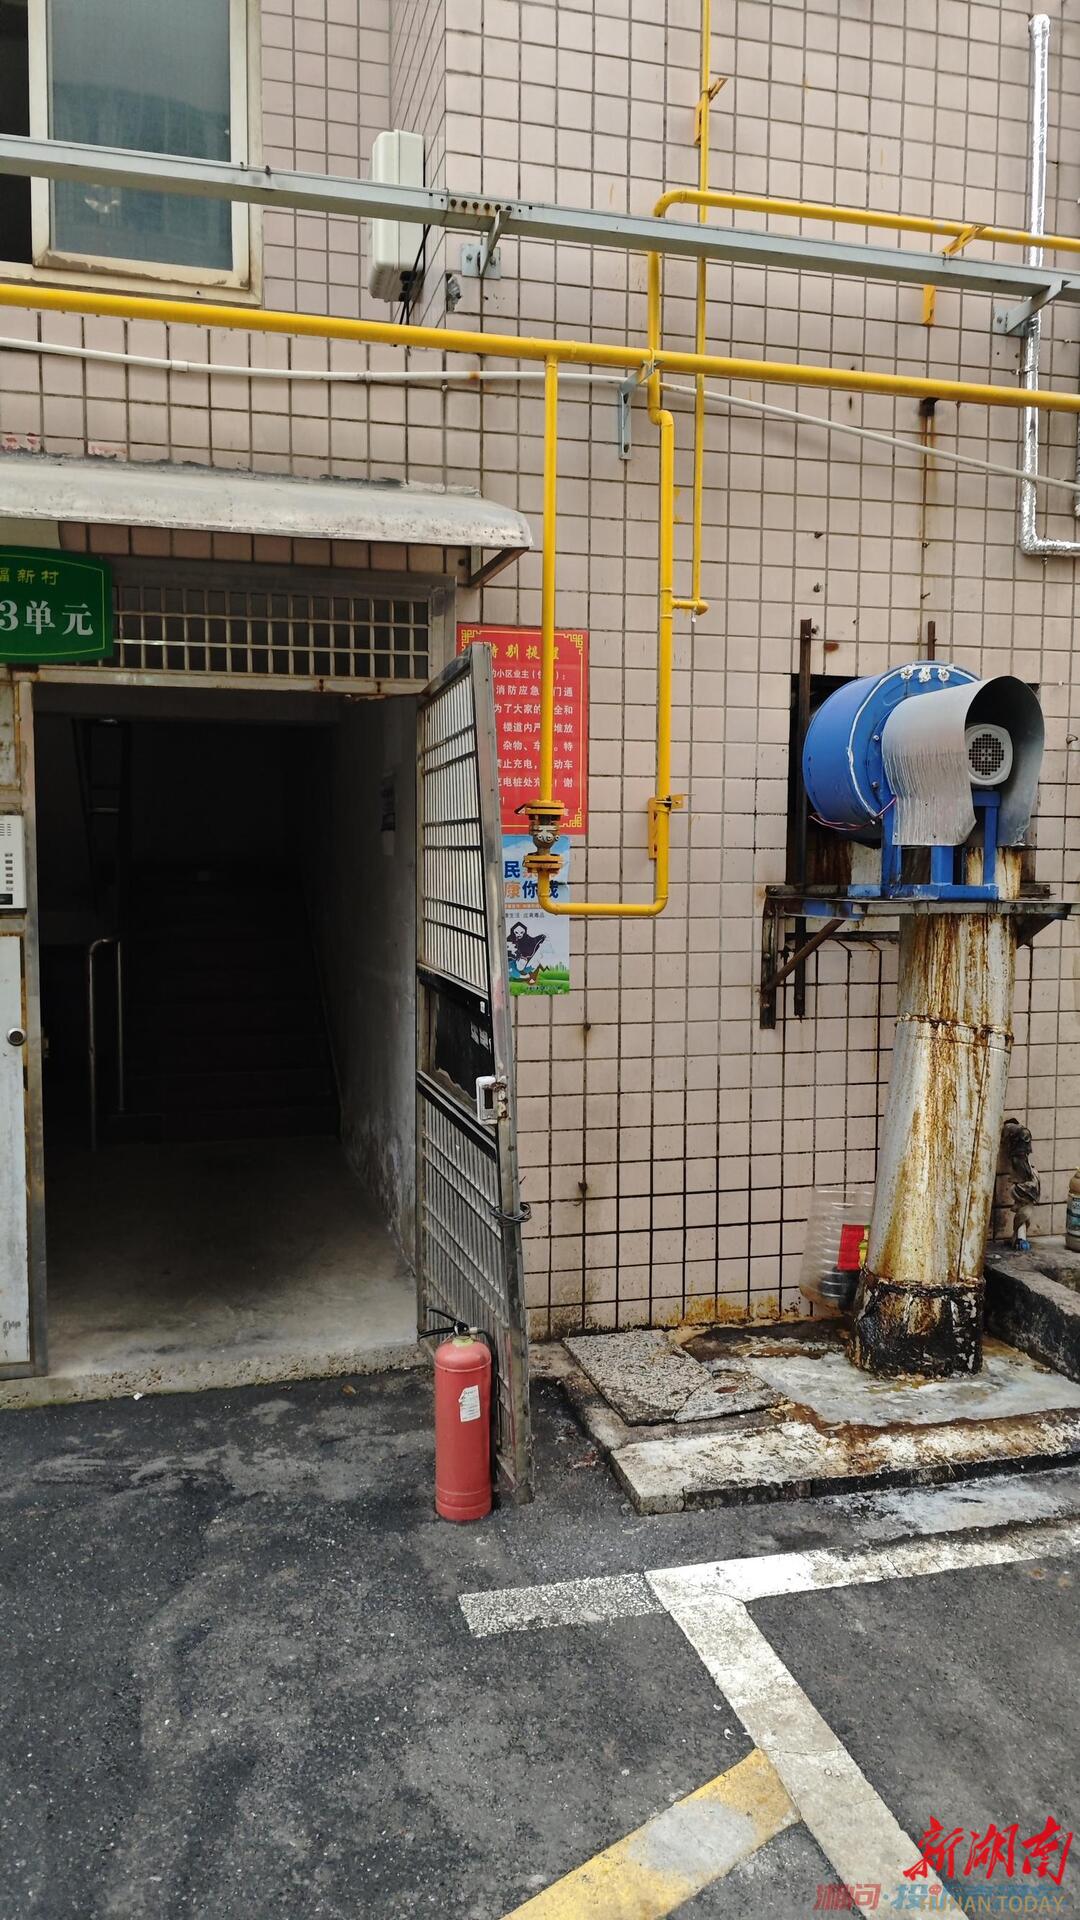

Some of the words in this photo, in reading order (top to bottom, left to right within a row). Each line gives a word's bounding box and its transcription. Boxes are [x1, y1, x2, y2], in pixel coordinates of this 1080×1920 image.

[0, 600, 93, 635] 3单元
[496, 685, 573, 697] 消防应急门通
[494, 704, 573, 715] 为了大家的全和
[503, 722, 573, 734] 楼道内严堆放
[503, 740, 573, 752] 杂物、车。特
